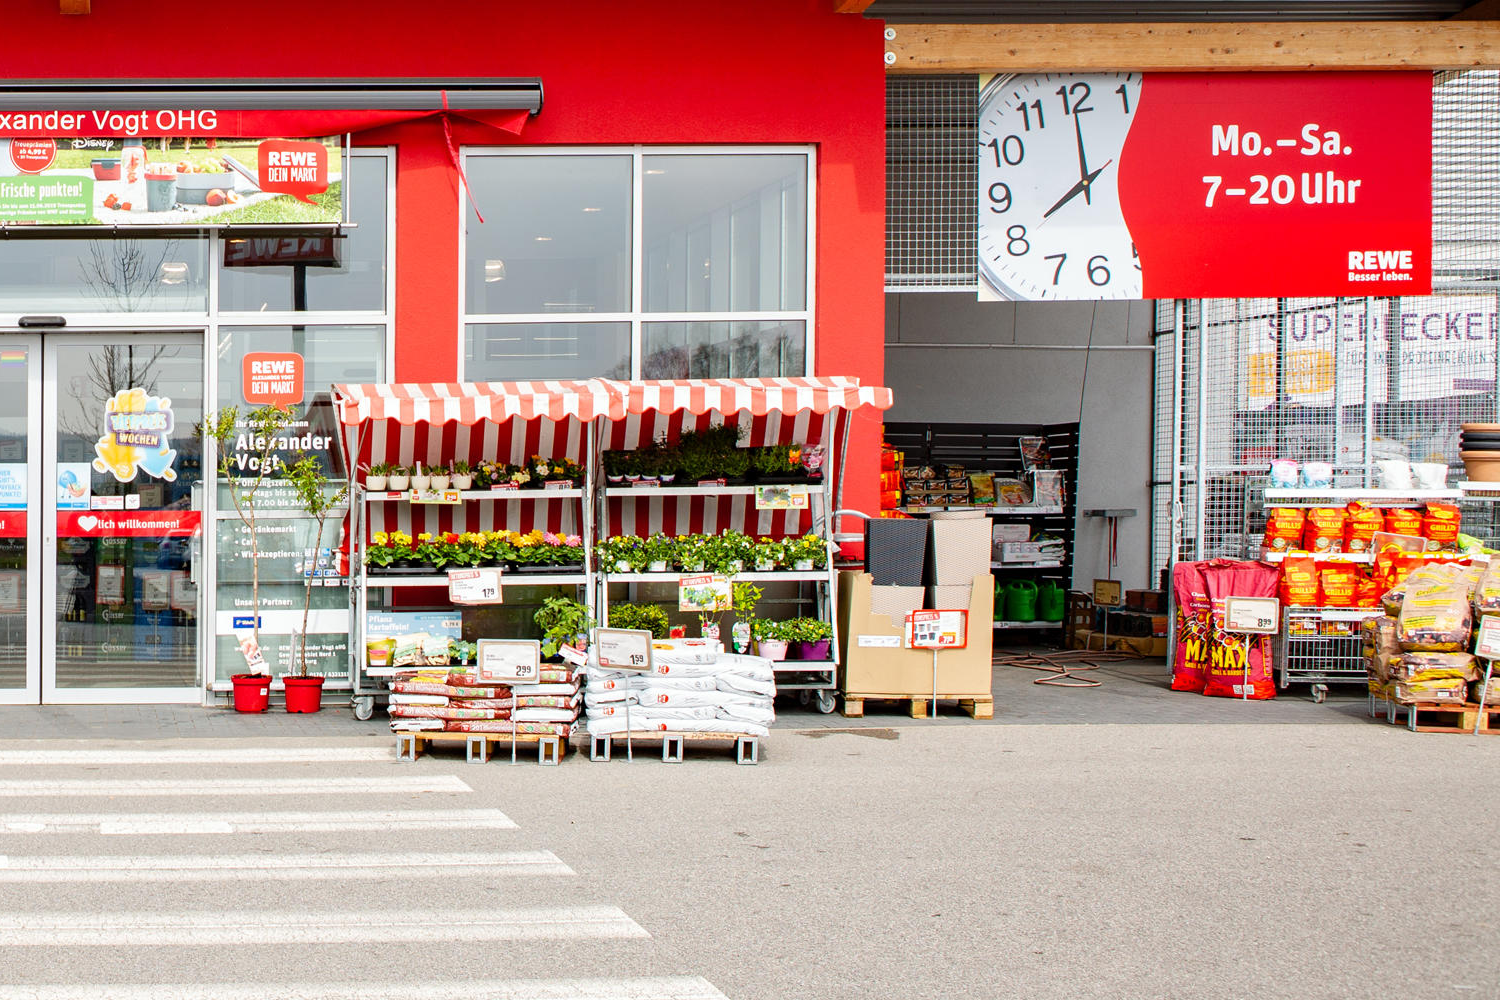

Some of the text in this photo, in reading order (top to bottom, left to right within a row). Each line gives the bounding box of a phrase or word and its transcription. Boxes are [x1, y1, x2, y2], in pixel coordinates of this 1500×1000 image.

[1055, 82, 1094, 115] 12
[1115, 83, 1130, 114] 1
[92, 110, 149, 135] Vogt
[155, 109, 218, 130] OHG
[1016, 99, 1046, 132] 11
[268, 151, 318, 167] REWE
[987, 134, 1025, 168] 10
[268, 167, 318, 182] DEIN MARKT
[1, 182, 35, 198] Frische
[40, 181, 83, 201] punkten!
[1301, 171, 1362, 204] Uhr
[988, 182, 1012, 214] 9
[1006, 225, 1030, 256] 8
[1044, 253, 1068, 286] 7
[1348, 250, 1413, 270] REWE
[1087, 255, 1111, 286] 6
[1348, 270, 1413, 281] Besser leben.
[251, 361, 295, 374] REWE
[252, 381, 295, 394] DEIN MARKT
[236, 420, 247, 428] Ihr
[119, 433, 159, 446] WOCHEN
[235, 432, 332, 450] Alexander
[235, 453, 280, 474] Vogt
[278, 498, 289, 506] bis
[98, 518, 180, 529] lich willkommen!
[241, 525, 297, 534] Geränkemarkt
[1275, 521, 1302, 529] GRILLIS
[1290, 586, 1317, 594] GRILLIS
[1324, 588, 1352, 596] GRILLIS
[263, 598, 293, 606] Partner:
[1185, 638, 1208, 662] MA
[1211, 645, 1251, 669] MAX
